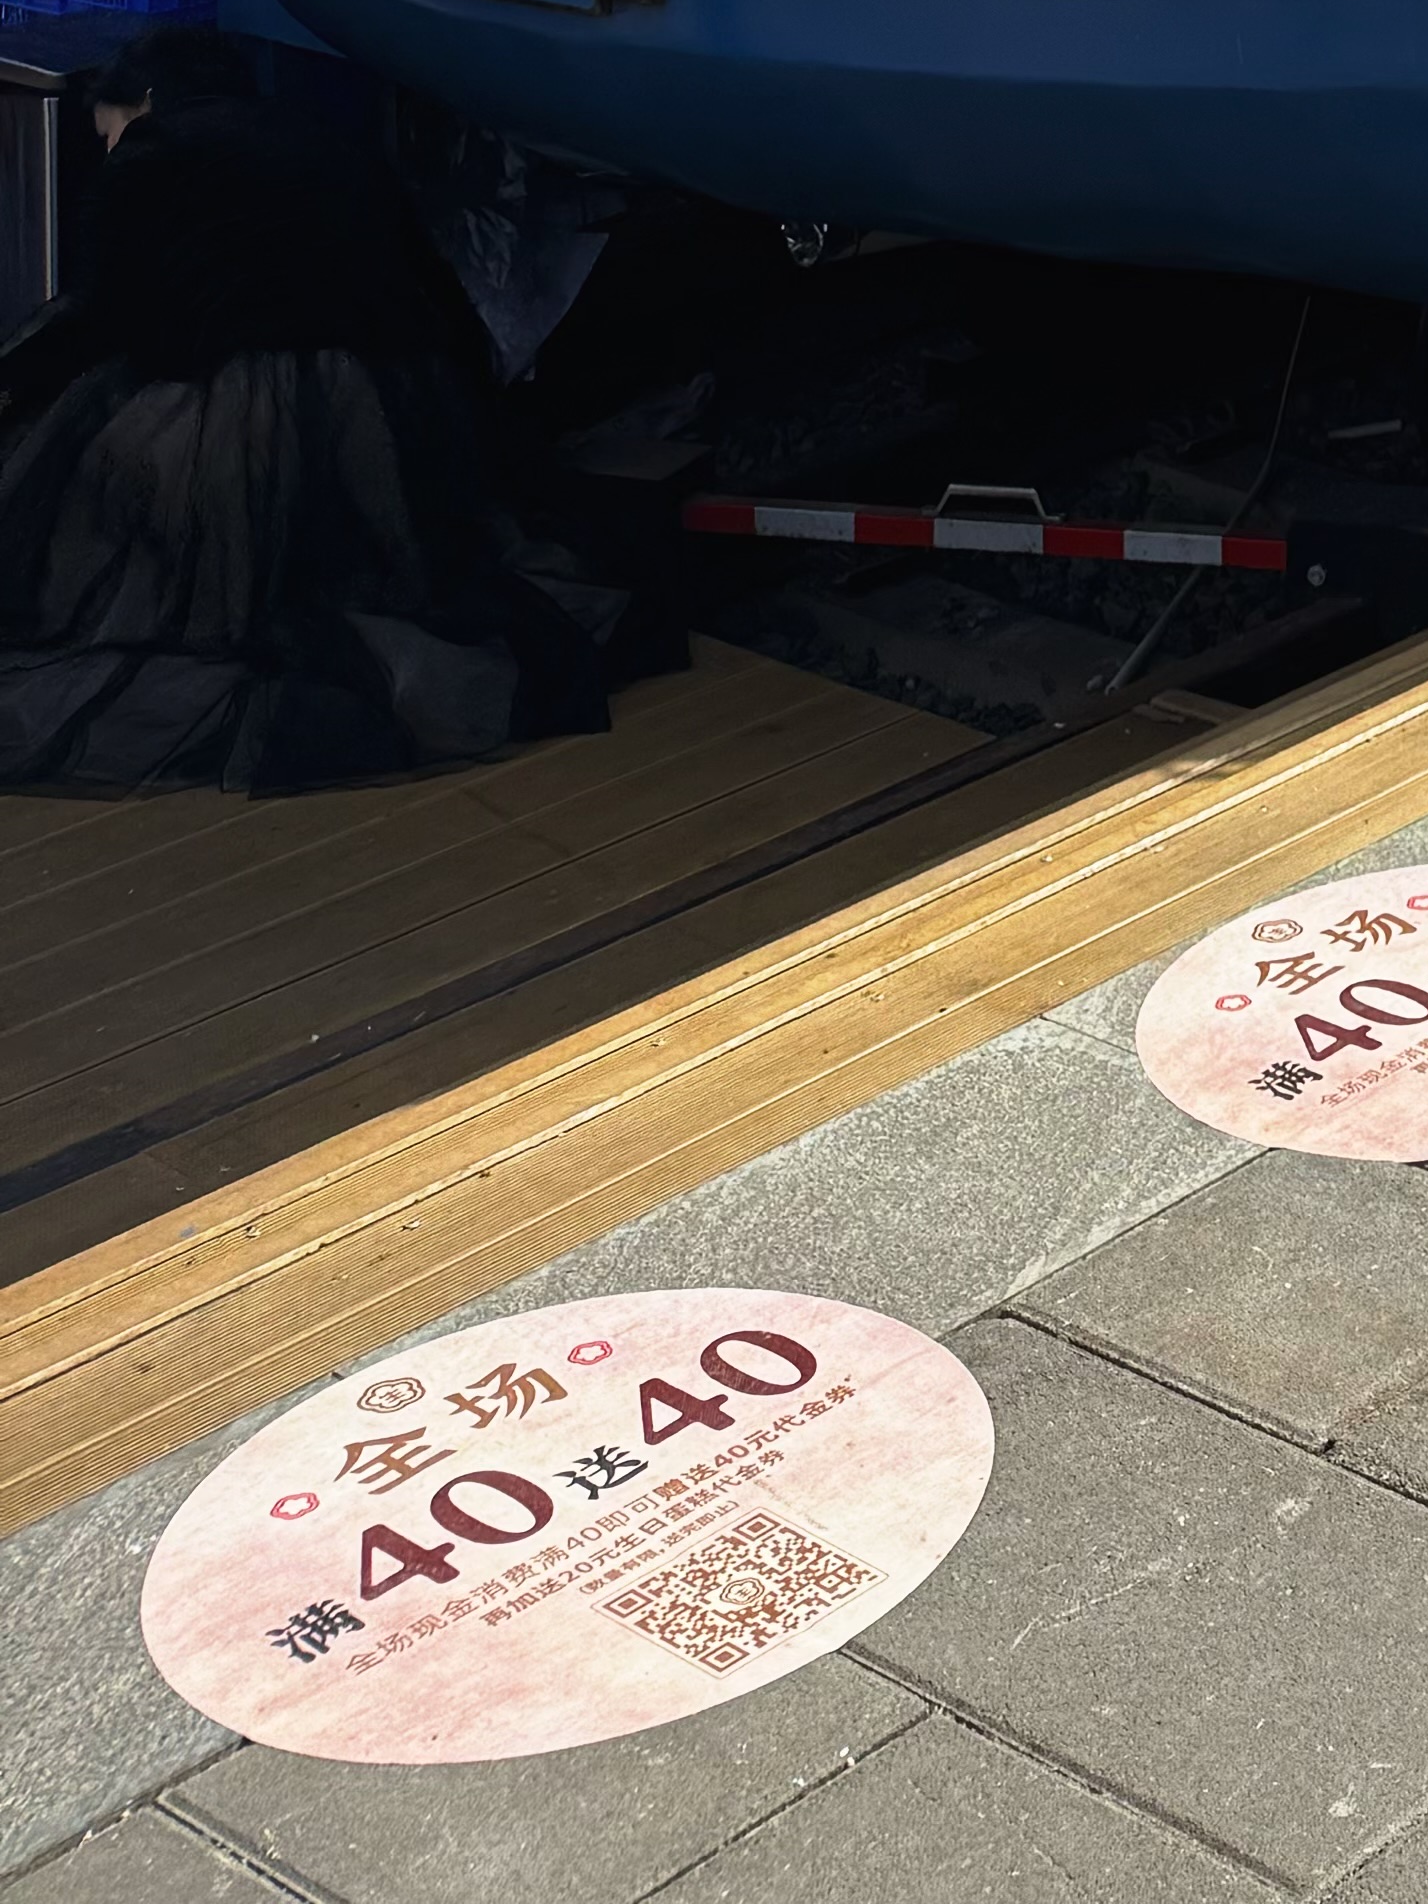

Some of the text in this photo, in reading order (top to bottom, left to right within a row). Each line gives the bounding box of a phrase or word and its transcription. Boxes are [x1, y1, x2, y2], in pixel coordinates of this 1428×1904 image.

[1256, 908, 1418, 995] 全场
[333, 1362, 569, 1496] 全场
[265, 1330, 818, 1664] 满40送40
